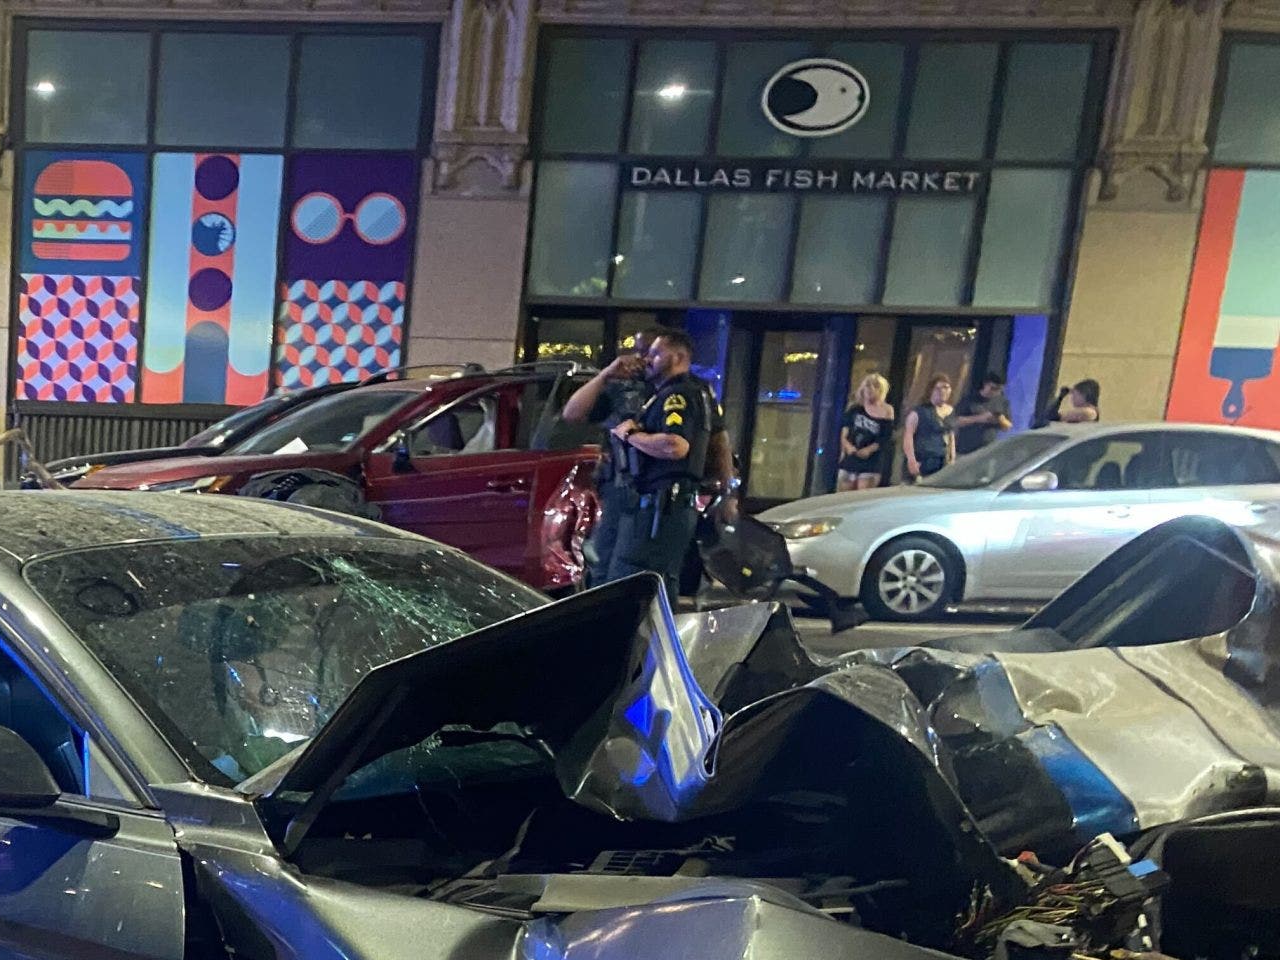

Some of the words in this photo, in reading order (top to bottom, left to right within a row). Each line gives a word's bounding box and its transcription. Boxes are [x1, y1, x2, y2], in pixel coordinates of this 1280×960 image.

[631, 166, 752, 187] DALLAS
[765, 169, 838, 189] FISH
[852, 171, 981, 192] MARKET
